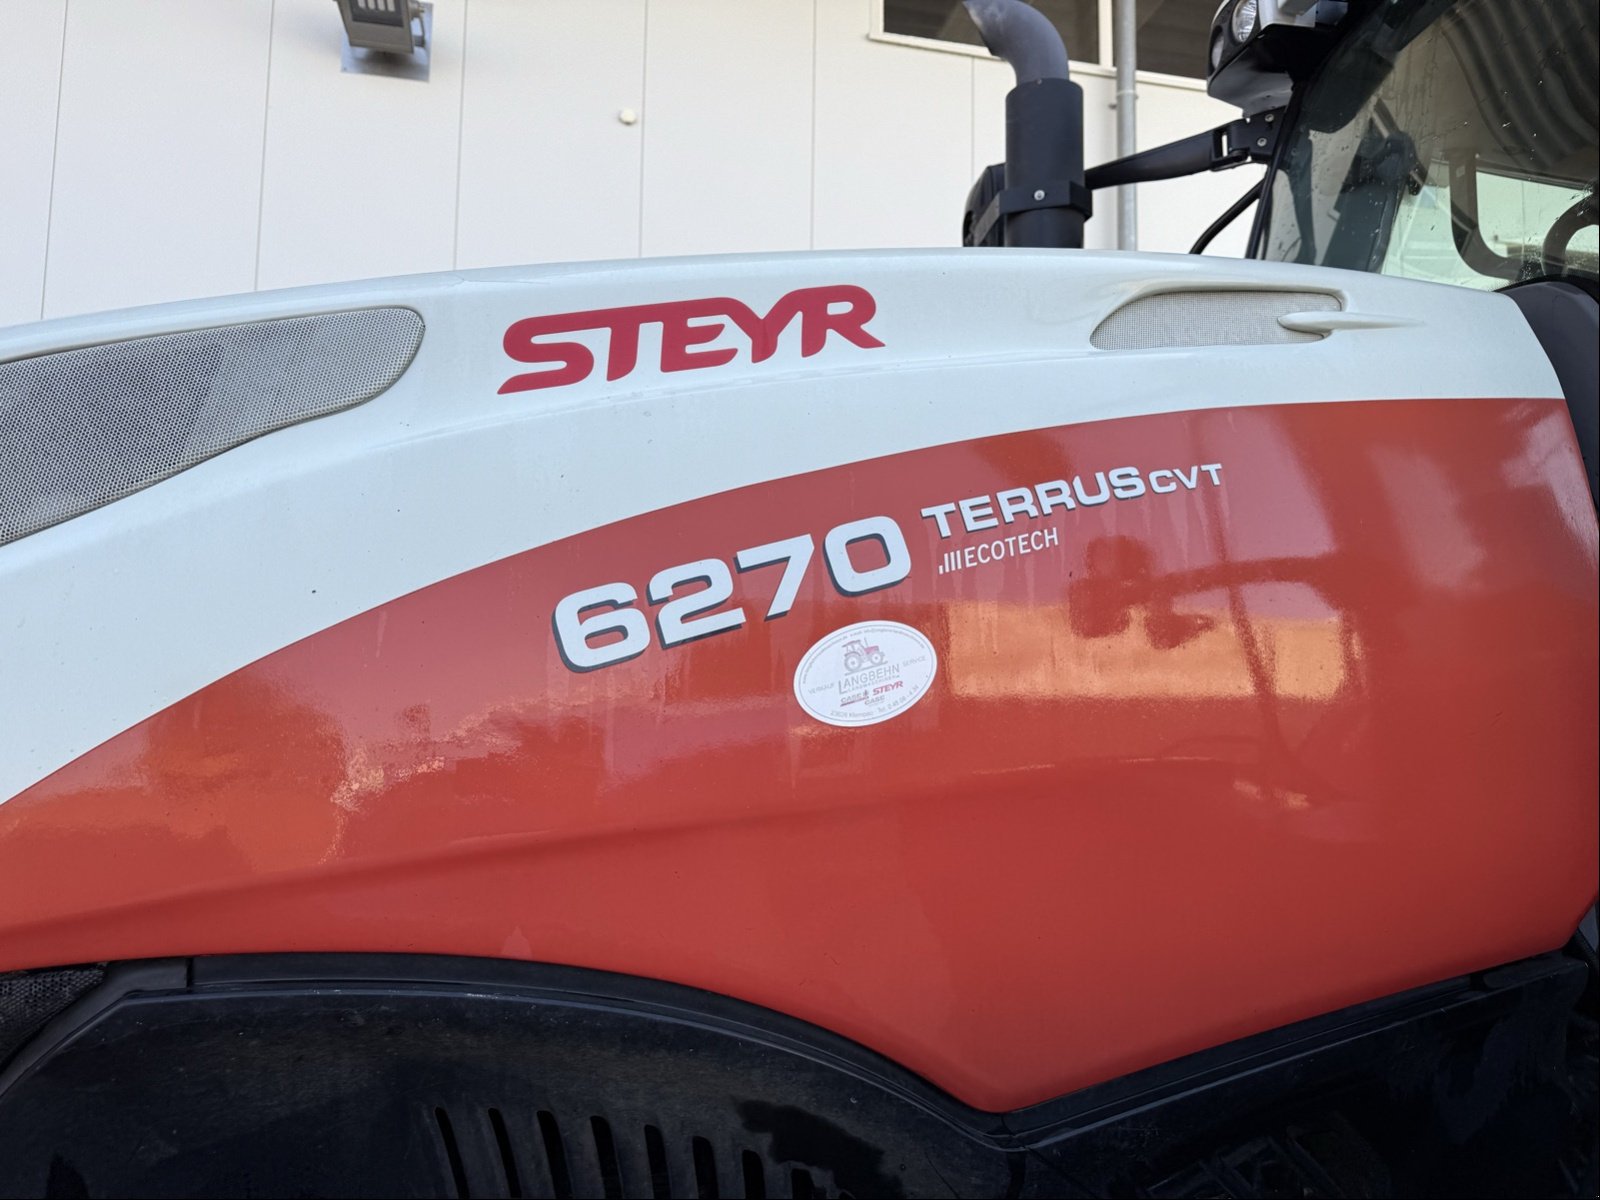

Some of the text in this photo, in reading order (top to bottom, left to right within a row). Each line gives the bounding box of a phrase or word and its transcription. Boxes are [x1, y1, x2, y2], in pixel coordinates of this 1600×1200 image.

[498, 285, 884, 395] STEYR
[921, 463, 1222, 538] TERRUS CVT
[964, 527, 1060, 568] ECOTECH
[553, 515, 912, 672] 6270
[838, 664, 900, 695] LANGBEHN
[840, 680, 904, 705] CASE STEYR
[864, 695, 886, 706] CASE
